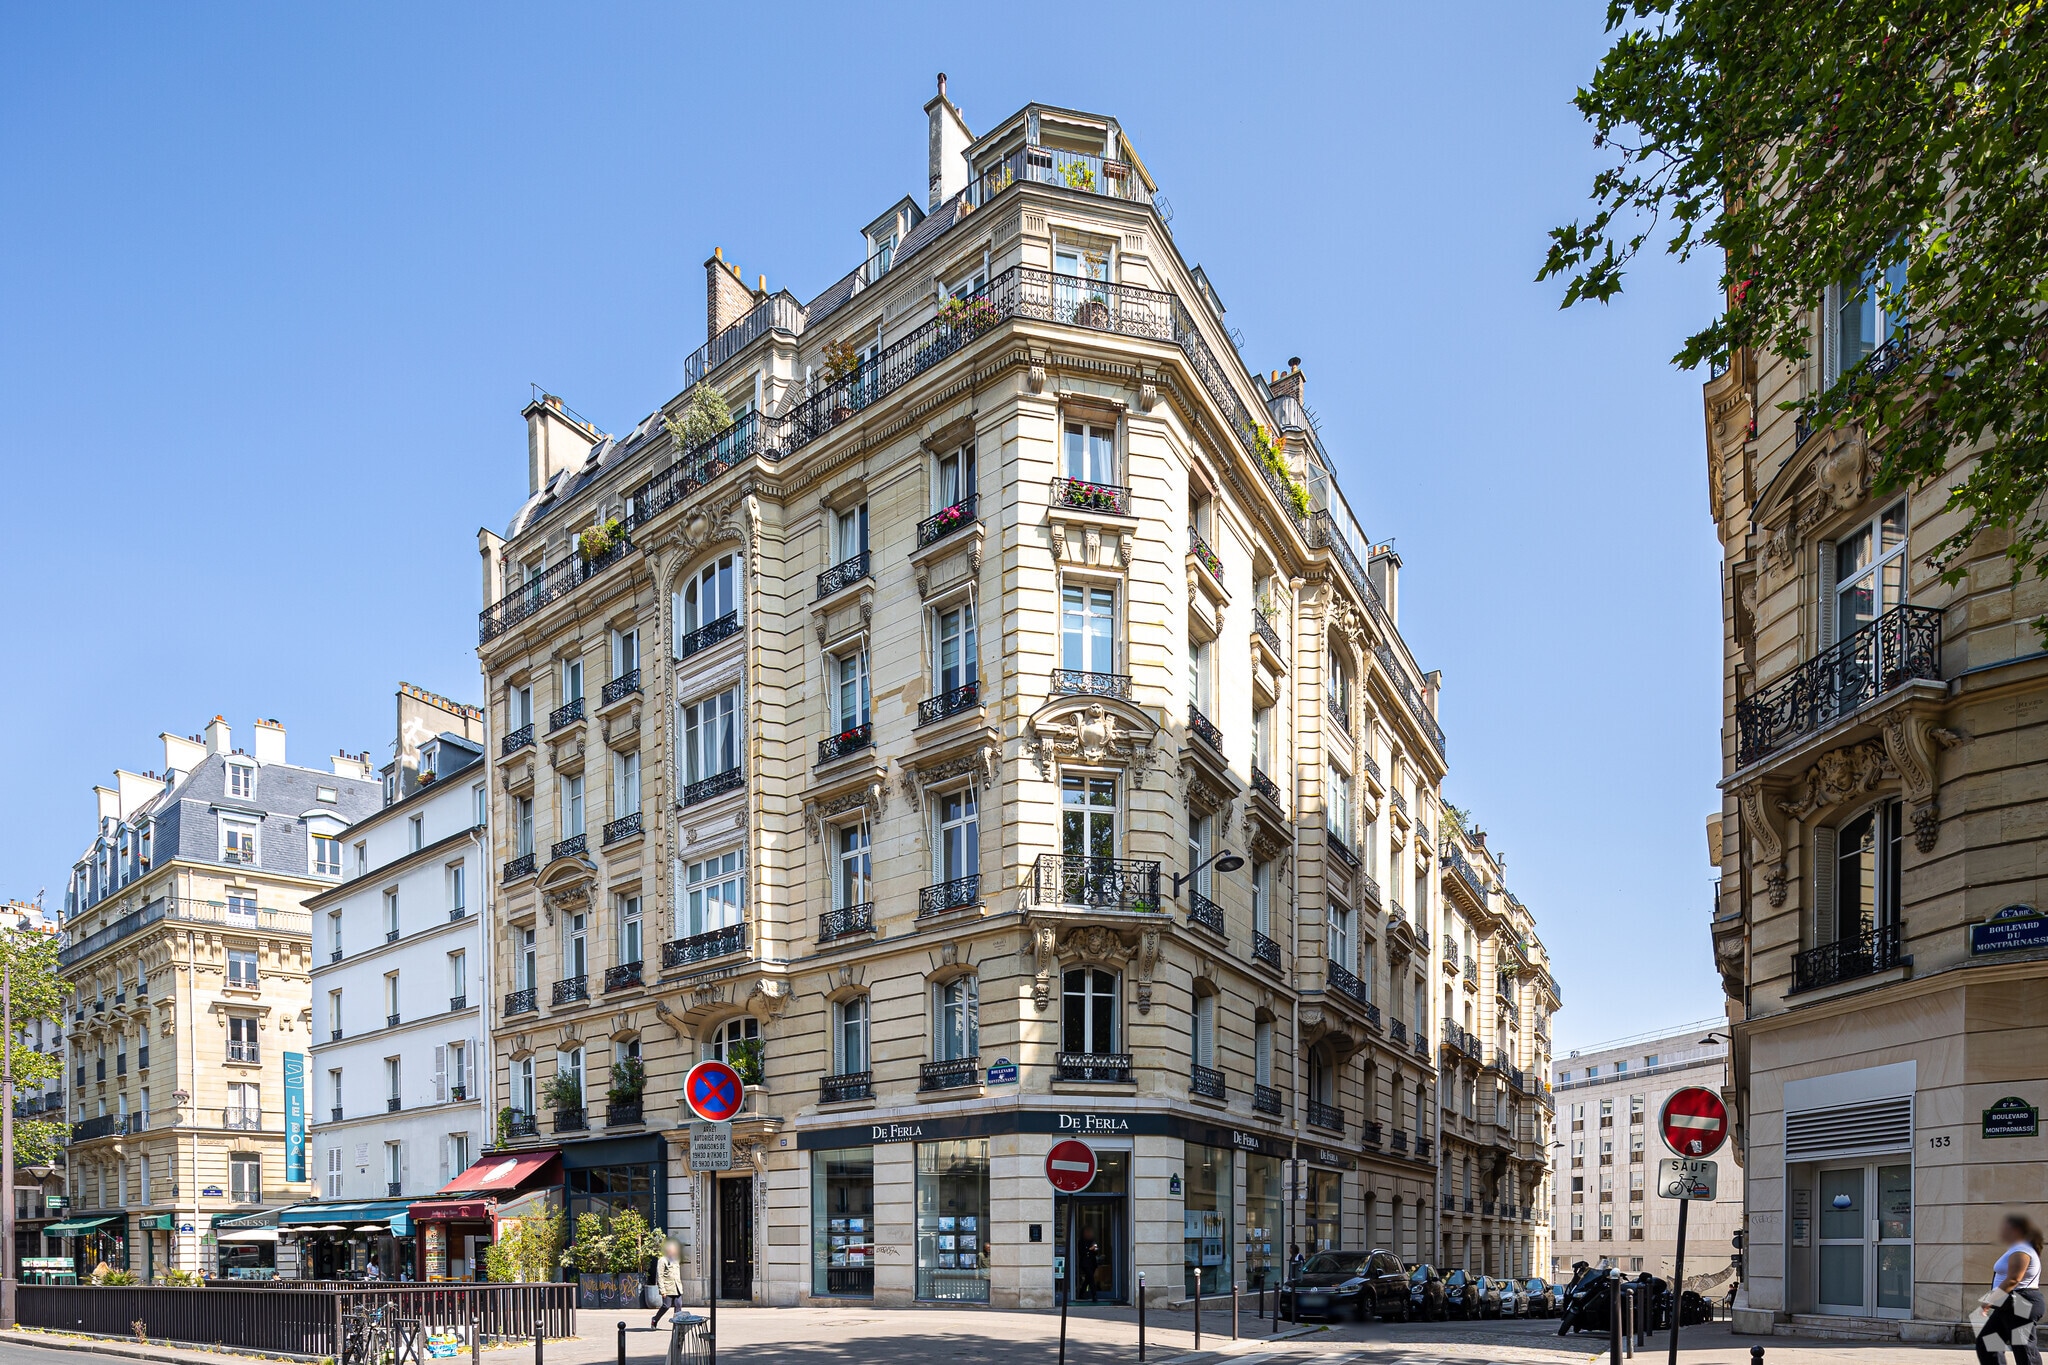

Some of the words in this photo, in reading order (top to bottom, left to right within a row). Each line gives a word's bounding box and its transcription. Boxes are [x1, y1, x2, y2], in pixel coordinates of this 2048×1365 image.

[1989, 921, 2040, 934] BOULEVARD
[2007, 931, 2021, 940] DU
[291, 1095, 301, 1117] LE
[1059, 1114, 1081, 1129] DE
[1085, 1114, 1129, 1130] FERLA
[872, 1125, 888, 1139] DE
[890, 1124, 923, 1138] FERLA
[1985, 1125, 2035, 1134] MONTPARNASSE
[290, 1122, 302, 1157] BOA
[1233, 1131, 1242, 1144] DE
[1242, 1133, 1259, 1148] FERLA
[1929, 1136, 1951, 1149] 133
[1320, 1149, 1327, 1160] DE
[1326, 1150, 1339, 1162] FERLA
[1671, 1161, 1708, 1173] SAUF
